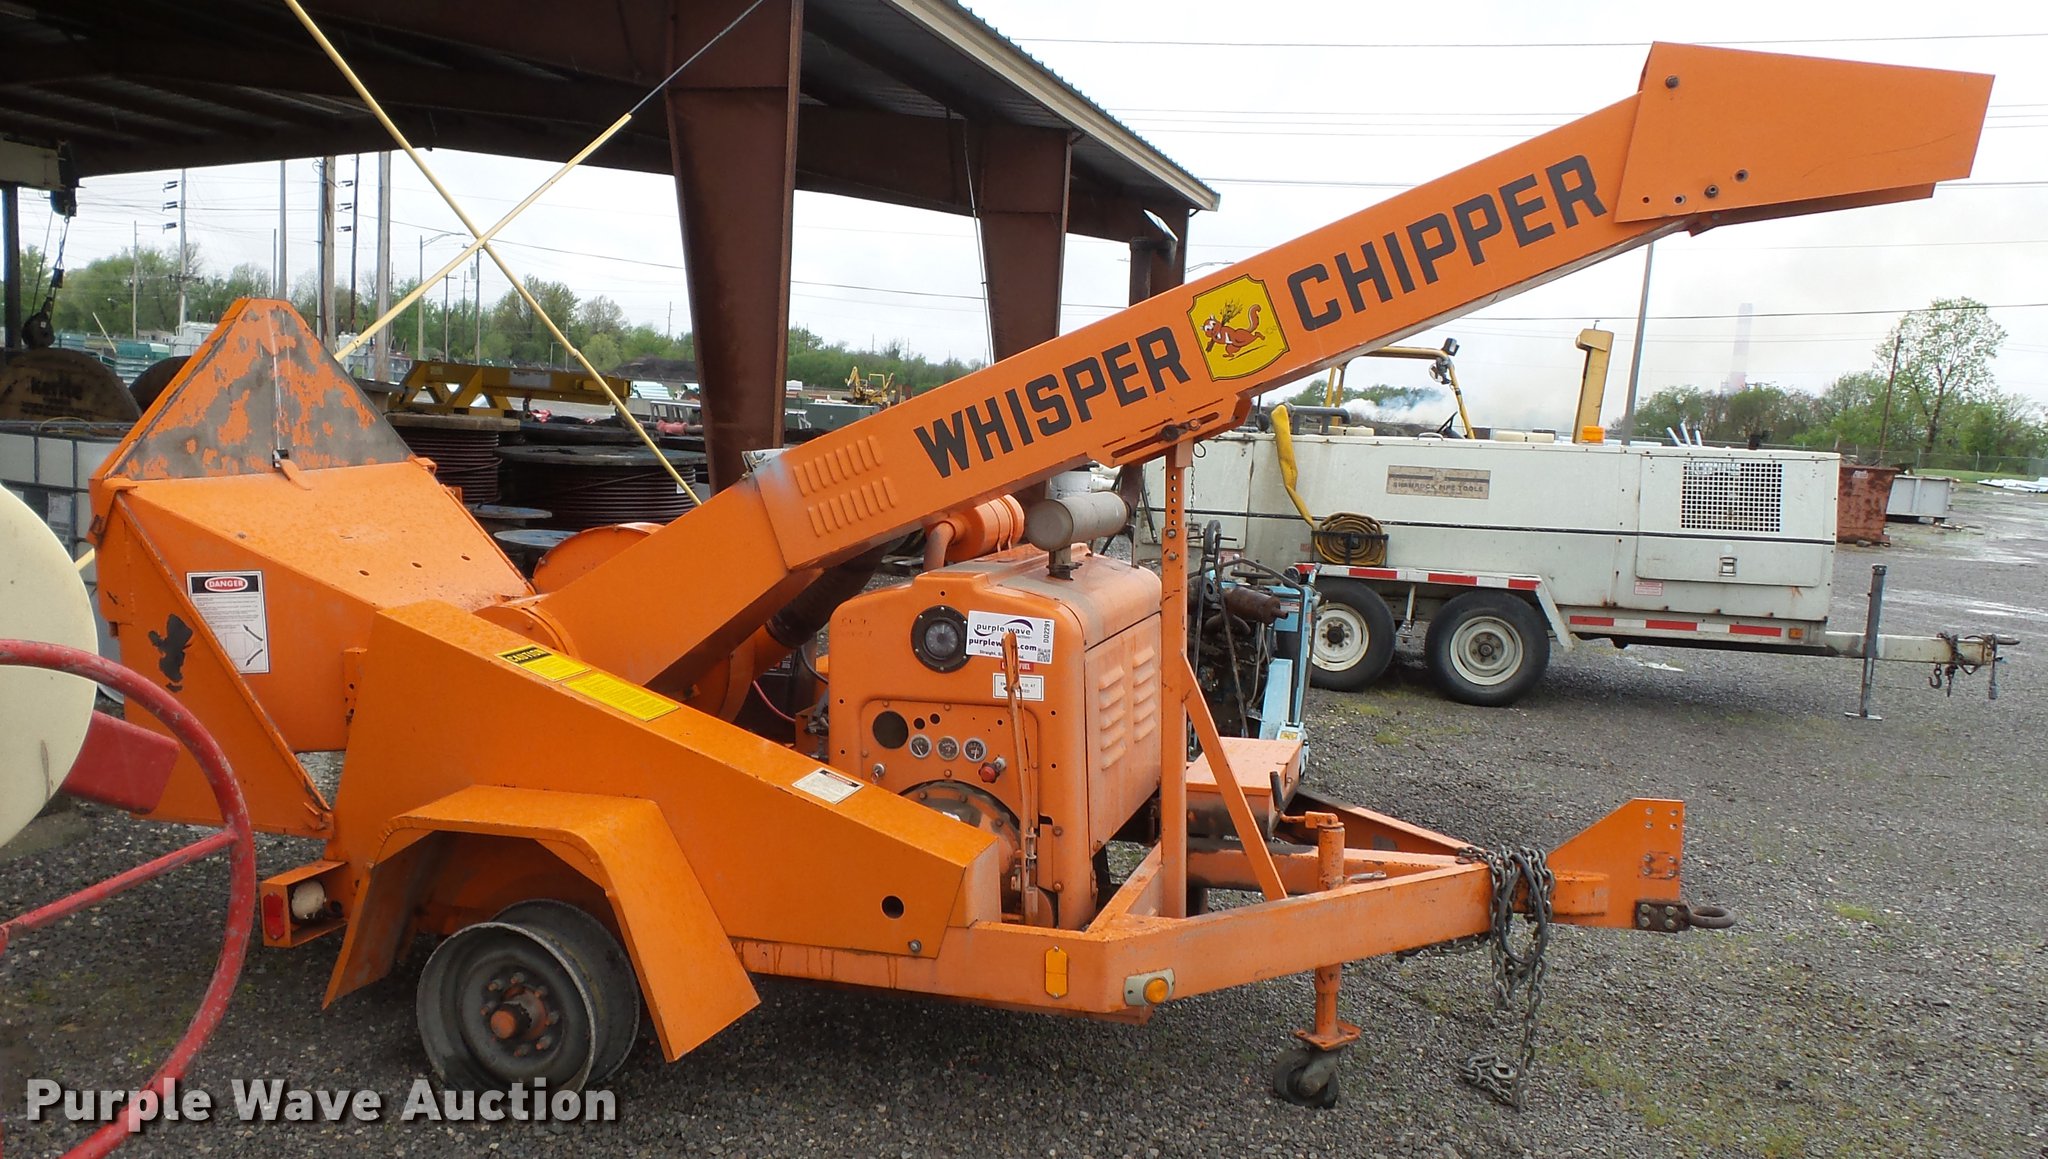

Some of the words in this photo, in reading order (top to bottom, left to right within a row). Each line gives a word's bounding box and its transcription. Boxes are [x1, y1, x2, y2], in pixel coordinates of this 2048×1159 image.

[914, 326, 1191, 479] WHISPER
[1287, 154, 1607, 331] CHIPPER
[1393, 482, 1436, 490] SHAMROCK
[1439, 483, 1456, 491] PIPE
[1459, 484, 1484, 492] TOOLS
[208, 580, 244, 588] DANGER
[977, 624, 1005, 633] purple
[968, 638, 1037, 652] purplew.com
[506, 648, 548, 663] CAUTION
